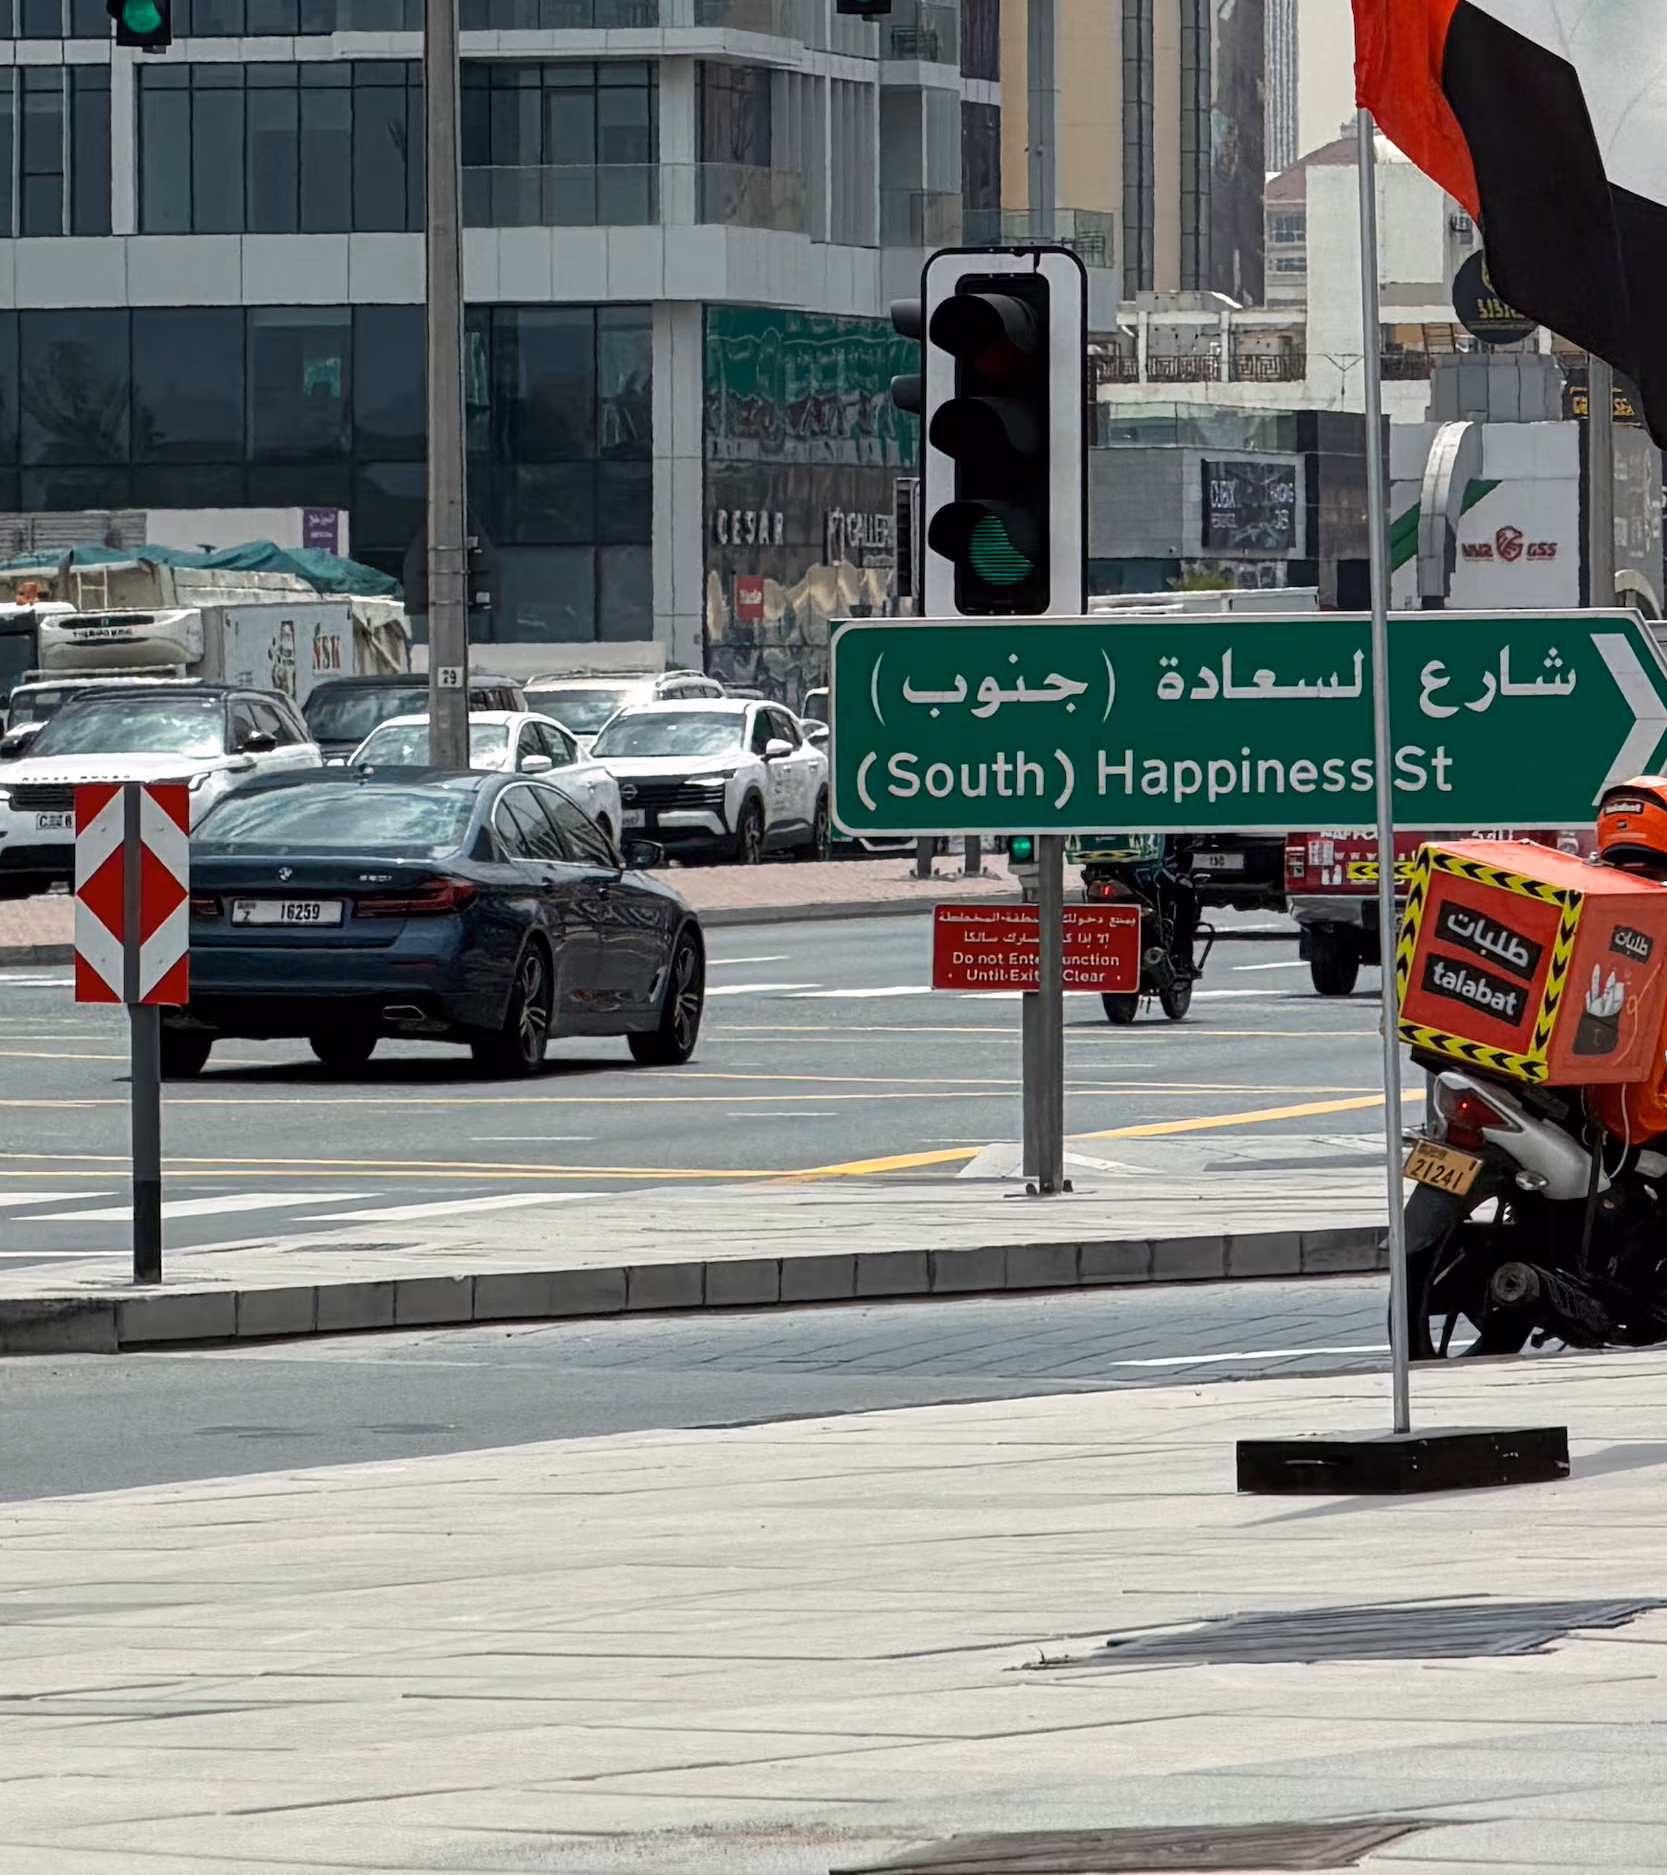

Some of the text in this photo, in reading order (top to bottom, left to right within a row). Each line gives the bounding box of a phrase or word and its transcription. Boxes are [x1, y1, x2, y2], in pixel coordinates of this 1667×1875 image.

[717, 507, 784, 546] CESAR
[869, 643, 1577, 725] شارع لسعادة (جنوب)
[855, 744, 1454, 812] (South) Happiness St
[280, 903, 320, 921] 16259
[953, 952, 1120, 966] Do not Ente unction
[1446, 911, 1530, 968] طلبات
[966, 968, 1105, 983] Until Exit Clear
[1432, 961, 1519, 1017] talabat
[1410, 1158, 1464, 1190] 21241
